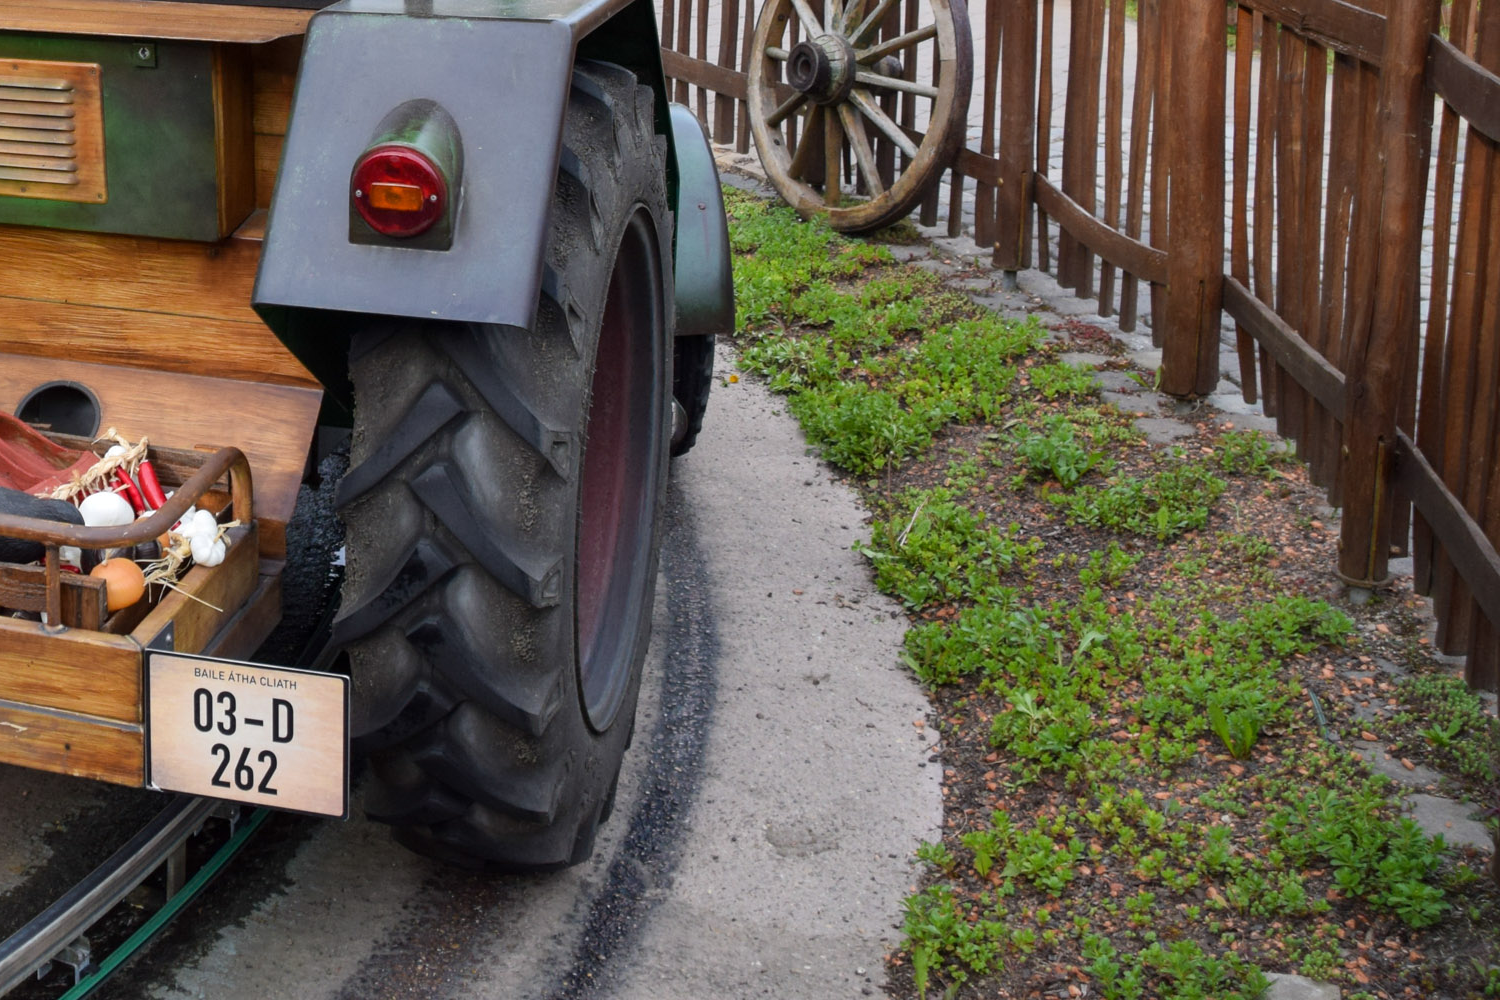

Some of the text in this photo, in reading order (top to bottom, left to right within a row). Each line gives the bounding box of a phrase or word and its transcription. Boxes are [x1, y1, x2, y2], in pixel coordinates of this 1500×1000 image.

[194, 667, 297, 690] BAILE ÁTHA CLIATH
[210, 742, 278, 796] 262
